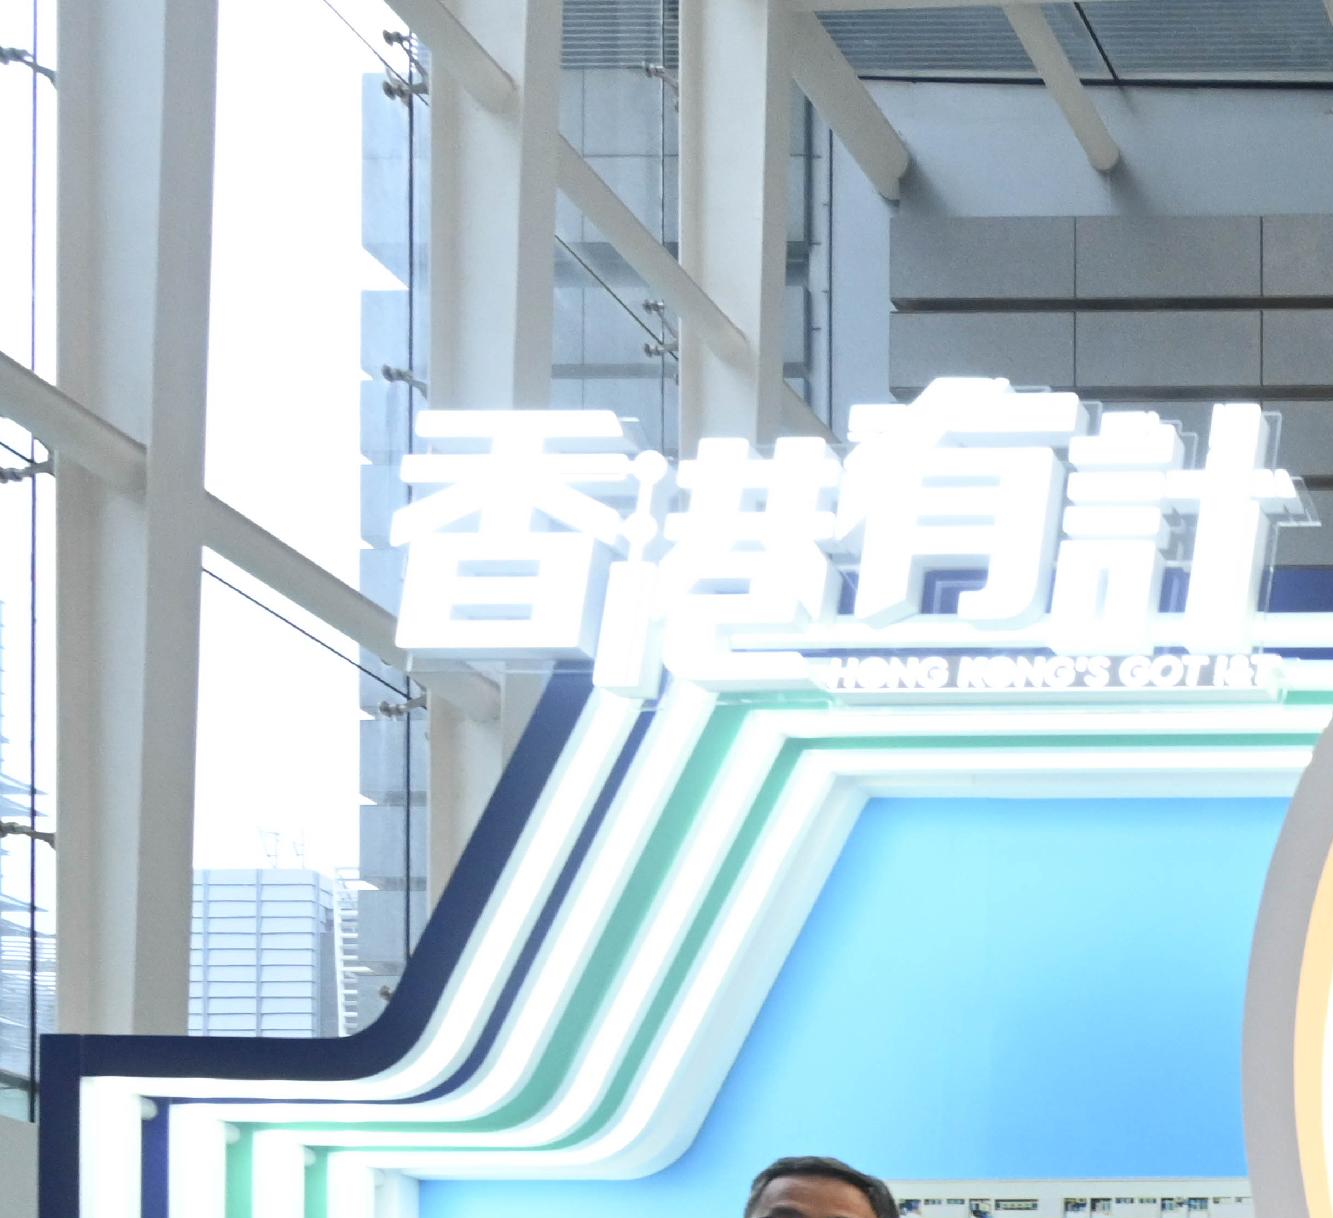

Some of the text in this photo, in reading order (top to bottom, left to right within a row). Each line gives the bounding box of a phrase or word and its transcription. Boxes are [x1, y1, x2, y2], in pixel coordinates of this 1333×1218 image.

[391, 377, 1300, 696] 香港有計
[829, 655, 949, 688] HONG
[956, 655, 1109, 688] KONG'S
[1118, 655, 1208, 688] GOT
